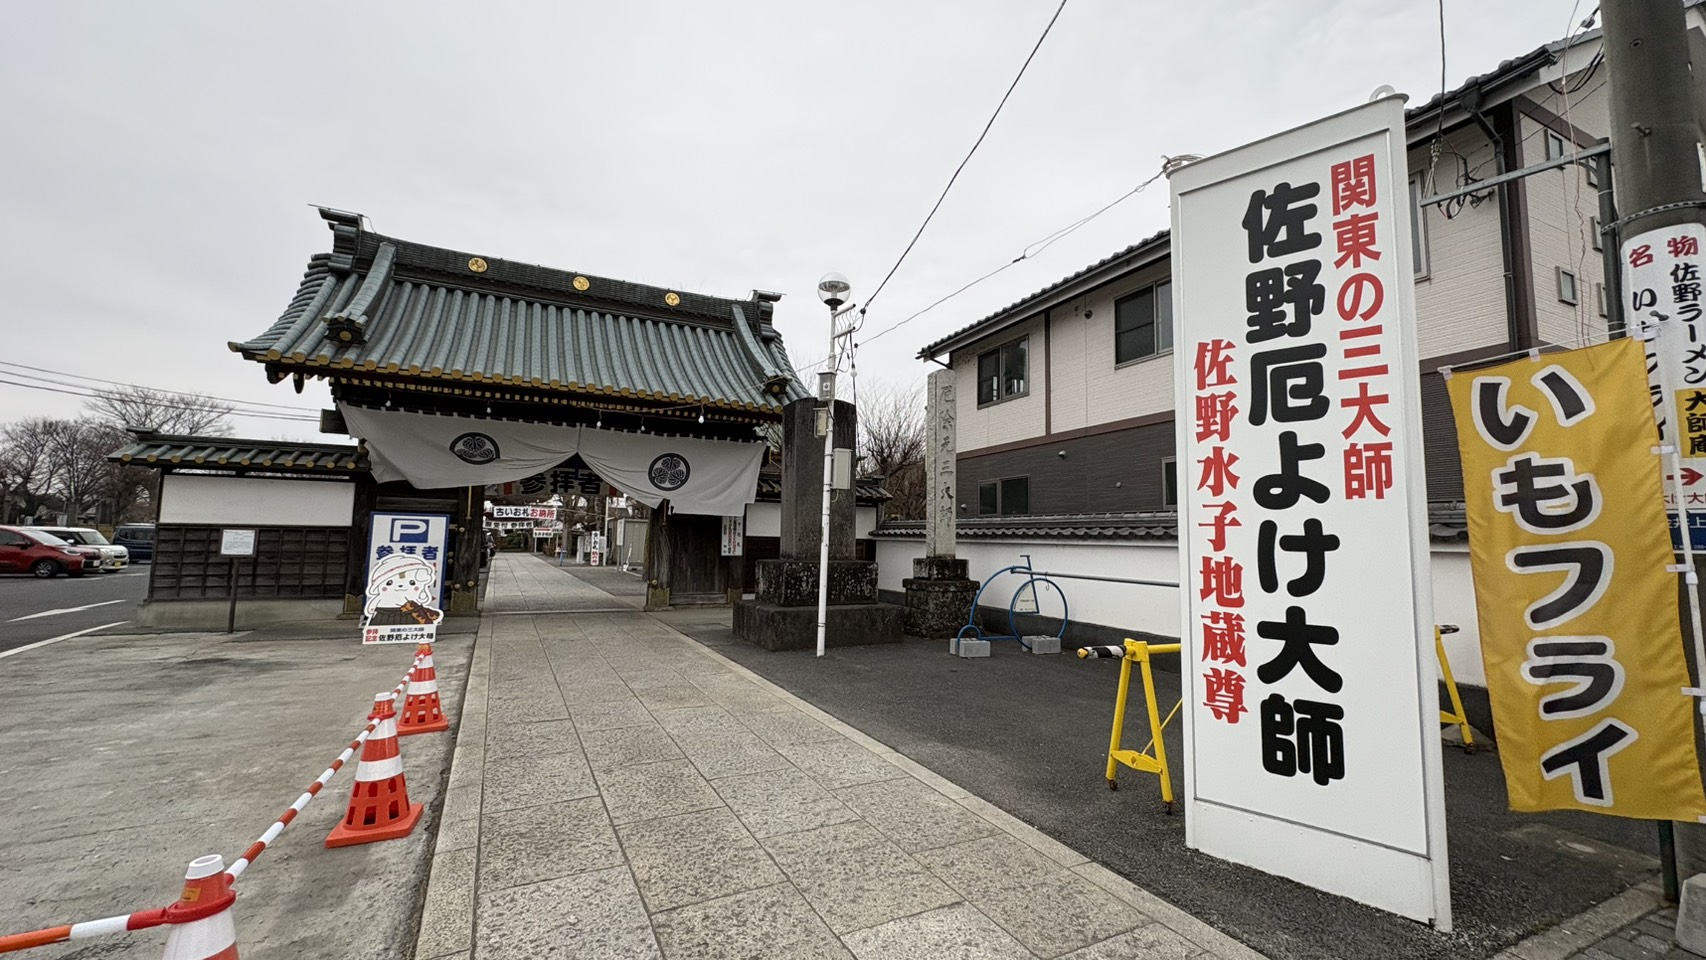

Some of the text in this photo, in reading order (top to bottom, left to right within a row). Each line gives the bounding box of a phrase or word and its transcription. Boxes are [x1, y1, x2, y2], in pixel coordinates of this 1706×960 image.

[1629, 236, 1699, 269] 名物
[1330, 153, 1393, 500] 関東の三大師
[1669, 262, 1706, 384] 佐野ラーメン
[519, 471, 603, 495] 参拝者
[1193, 338, 1249, 724] 佐野水子地蔵尊
[1241, 181, 1345, 786] 佐野厄よけ大師
[376, 545, 439, 560] 参拝者
[1473, 365, 1637, 806] いもフライ
[378, 632, 434, 641] 佐野厄よけ大師
